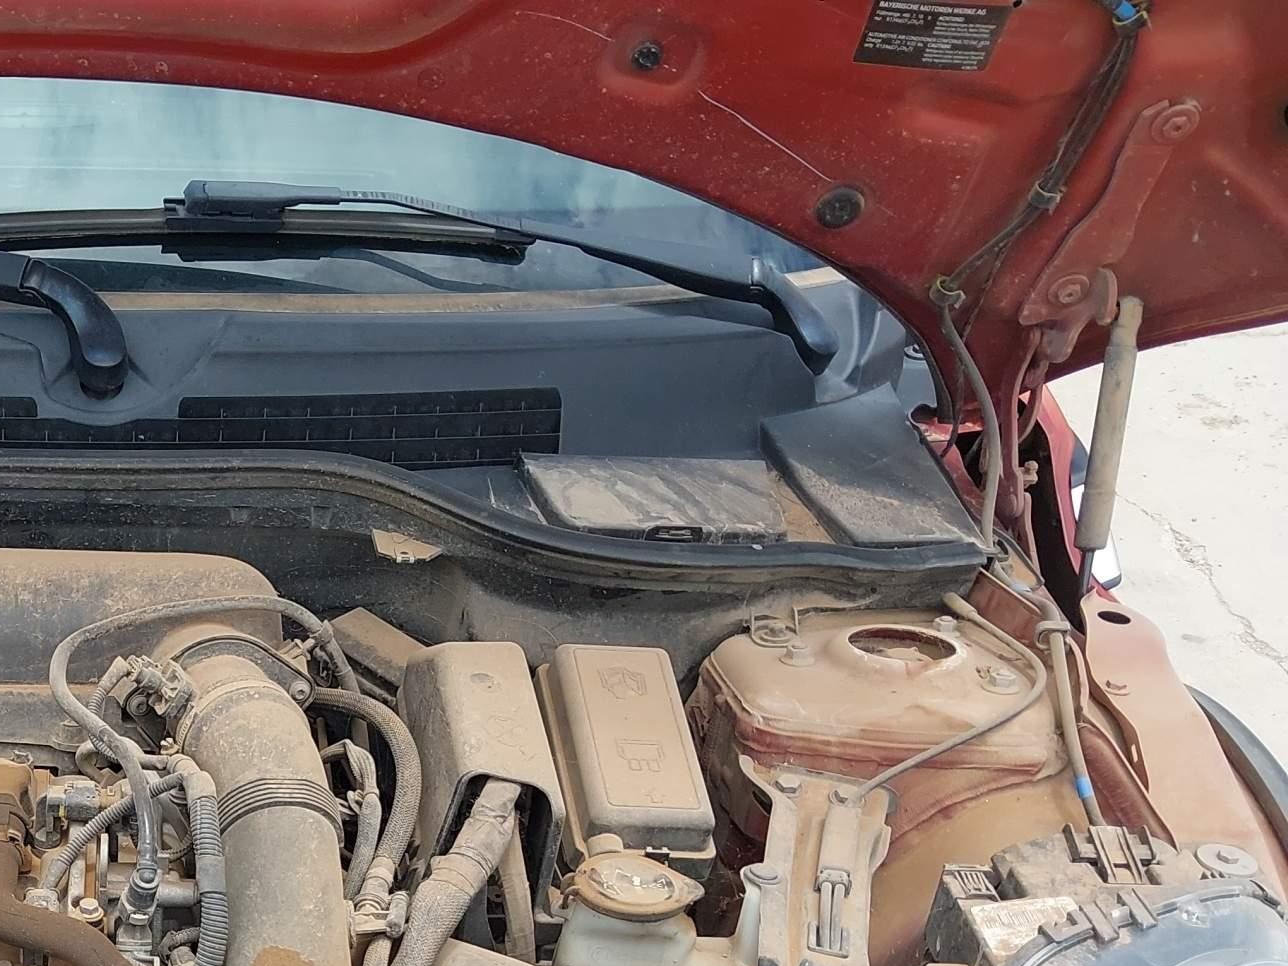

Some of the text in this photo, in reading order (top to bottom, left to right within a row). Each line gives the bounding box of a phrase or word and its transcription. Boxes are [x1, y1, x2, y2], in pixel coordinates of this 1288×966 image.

[879, 1, 920, 11] BAYERISCHE
[920, 5, 953, 13] MOTOREN
[976, 8, 988, 16] AG
